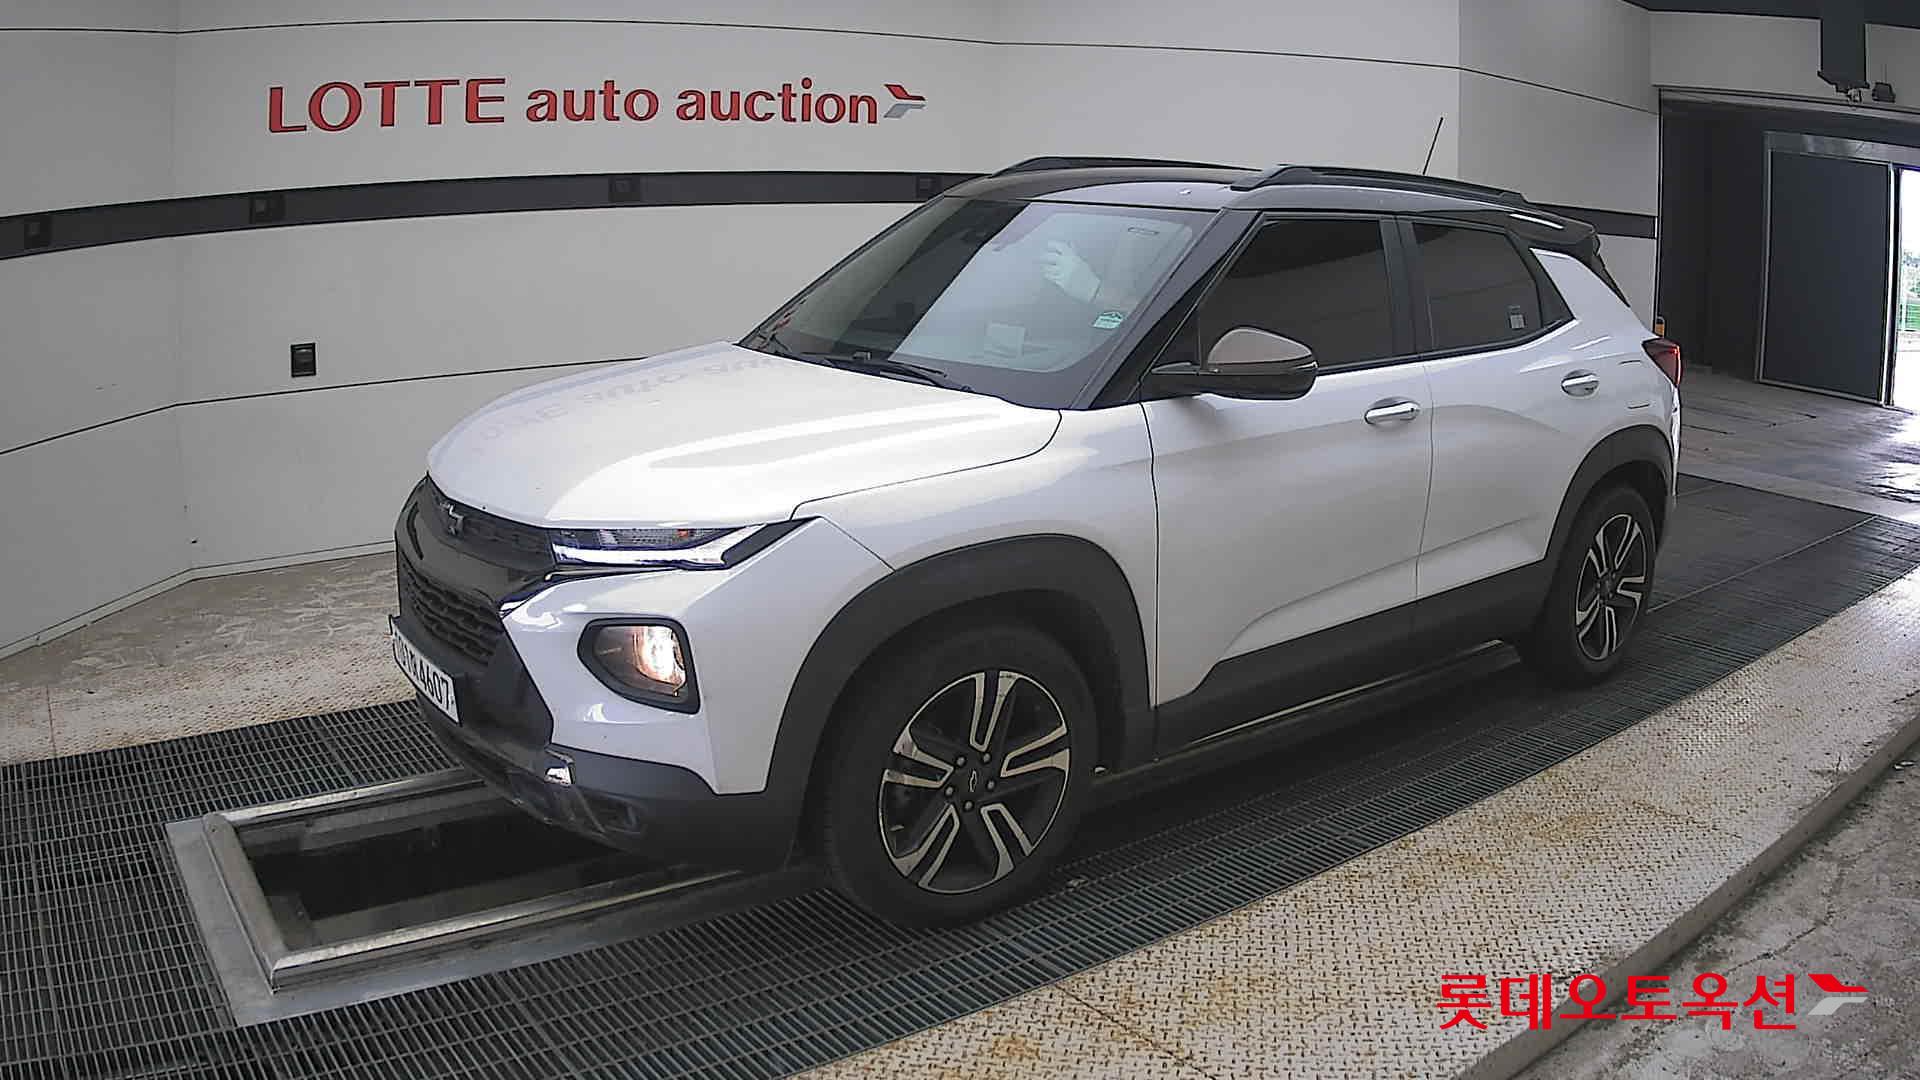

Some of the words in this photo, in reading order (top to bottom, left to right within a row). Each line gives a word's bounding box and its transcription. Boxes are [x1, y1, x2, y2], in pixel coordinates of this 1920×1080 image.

[269, 78, 505, 133] LOTTE
[526, 80, 660, 122] auto
[675, 77, 878, 124] auction
